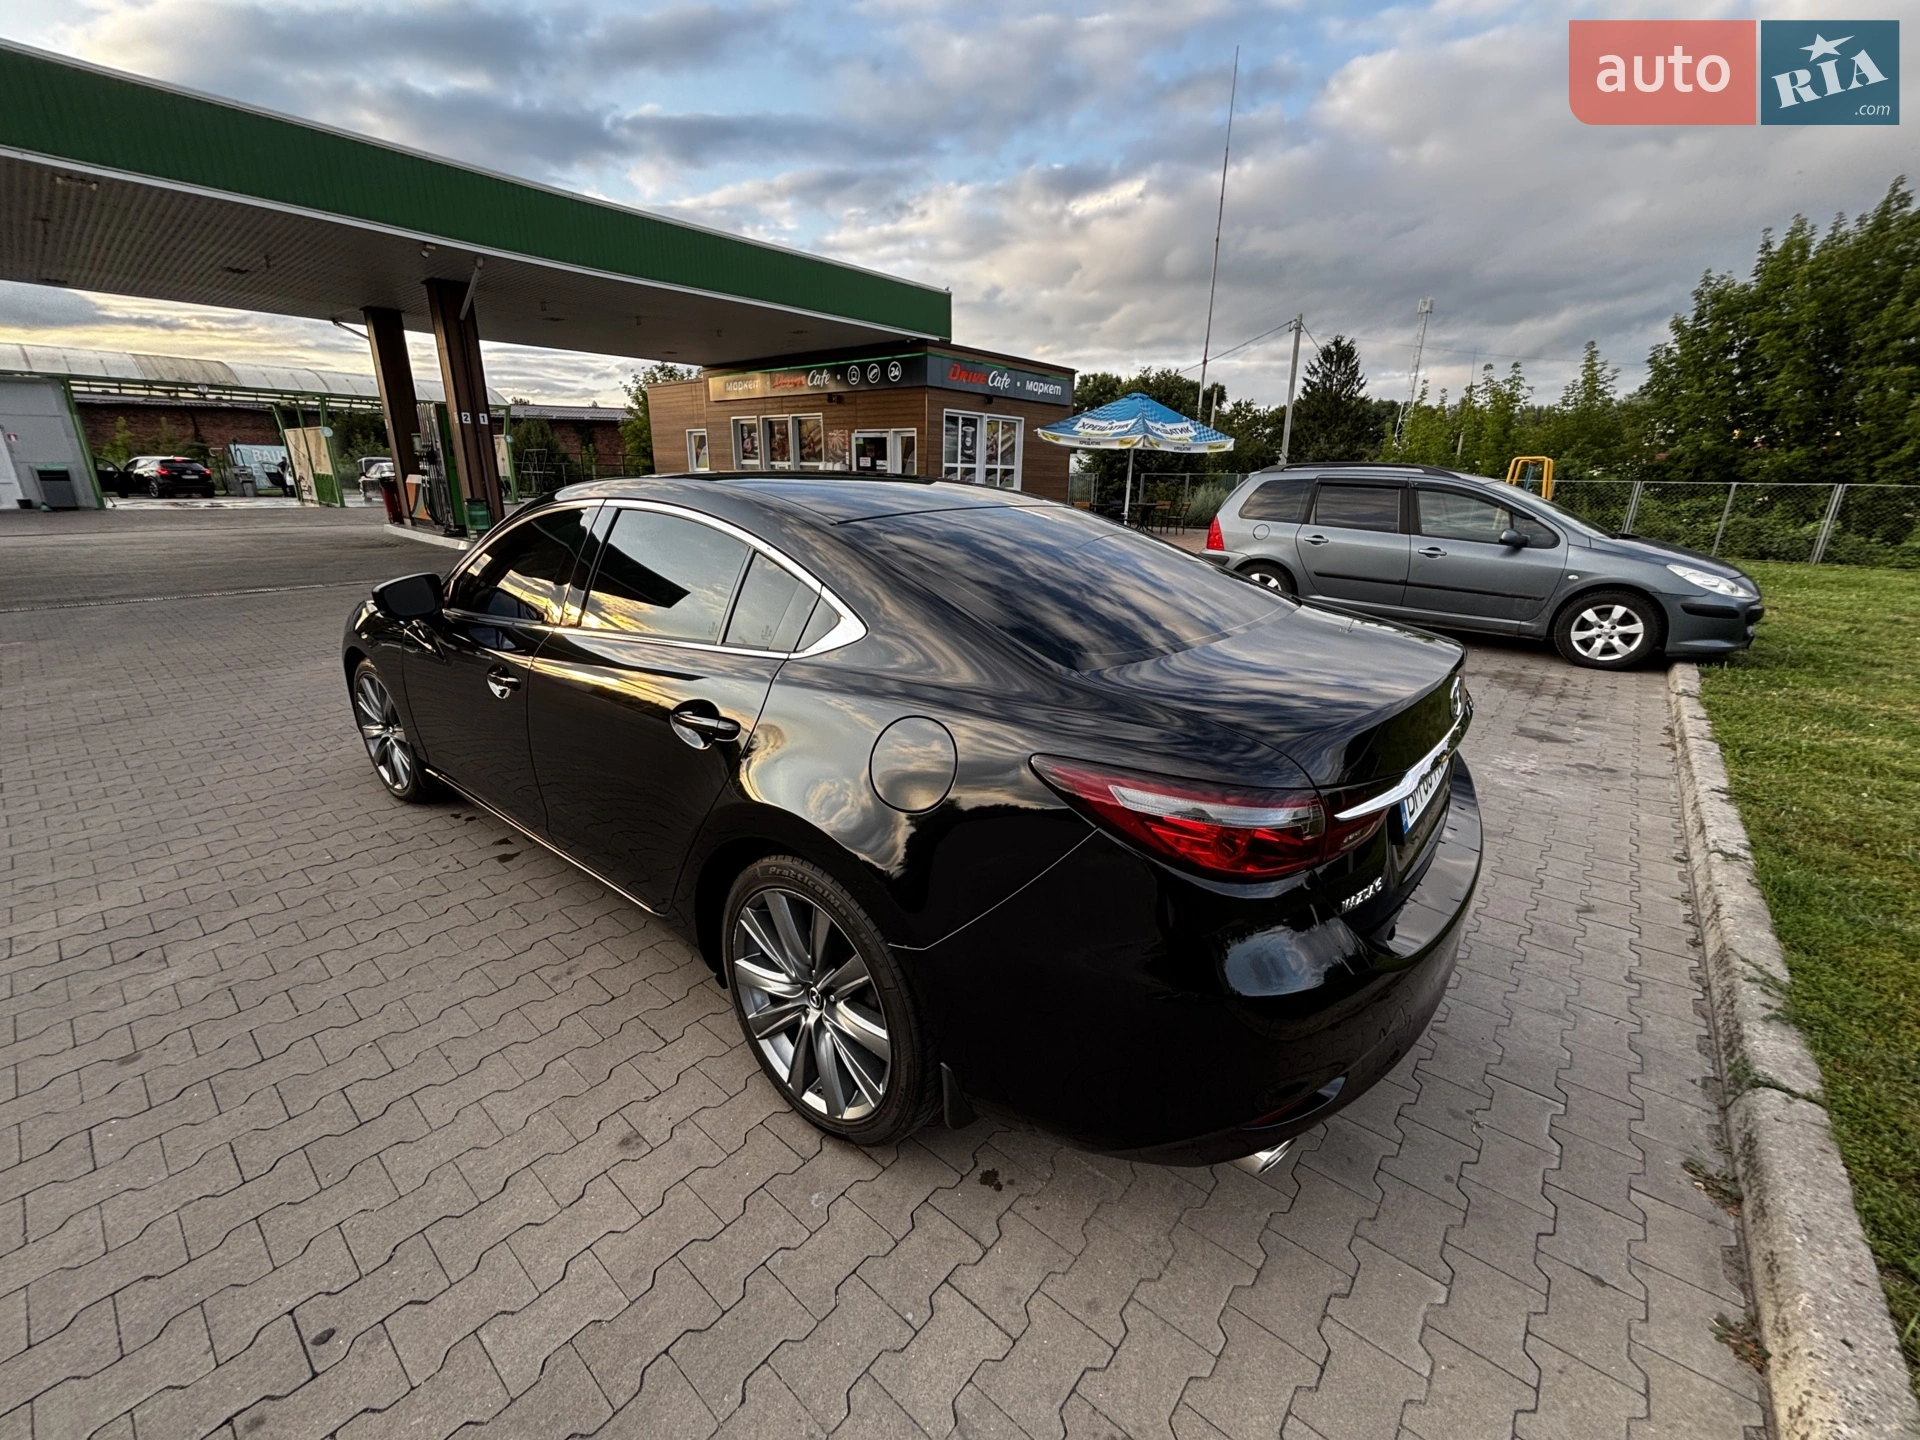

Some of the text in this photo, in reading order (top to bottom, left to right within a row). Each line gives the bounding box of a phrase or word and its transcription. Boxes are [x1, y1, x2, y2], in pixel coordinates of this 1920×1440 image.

[807, 368, 831, 387] Cafe
[890, 366, 900, 376] 24
[988, 370, 1011, 390] Cafe
[463, 413, 469, 422] 2
